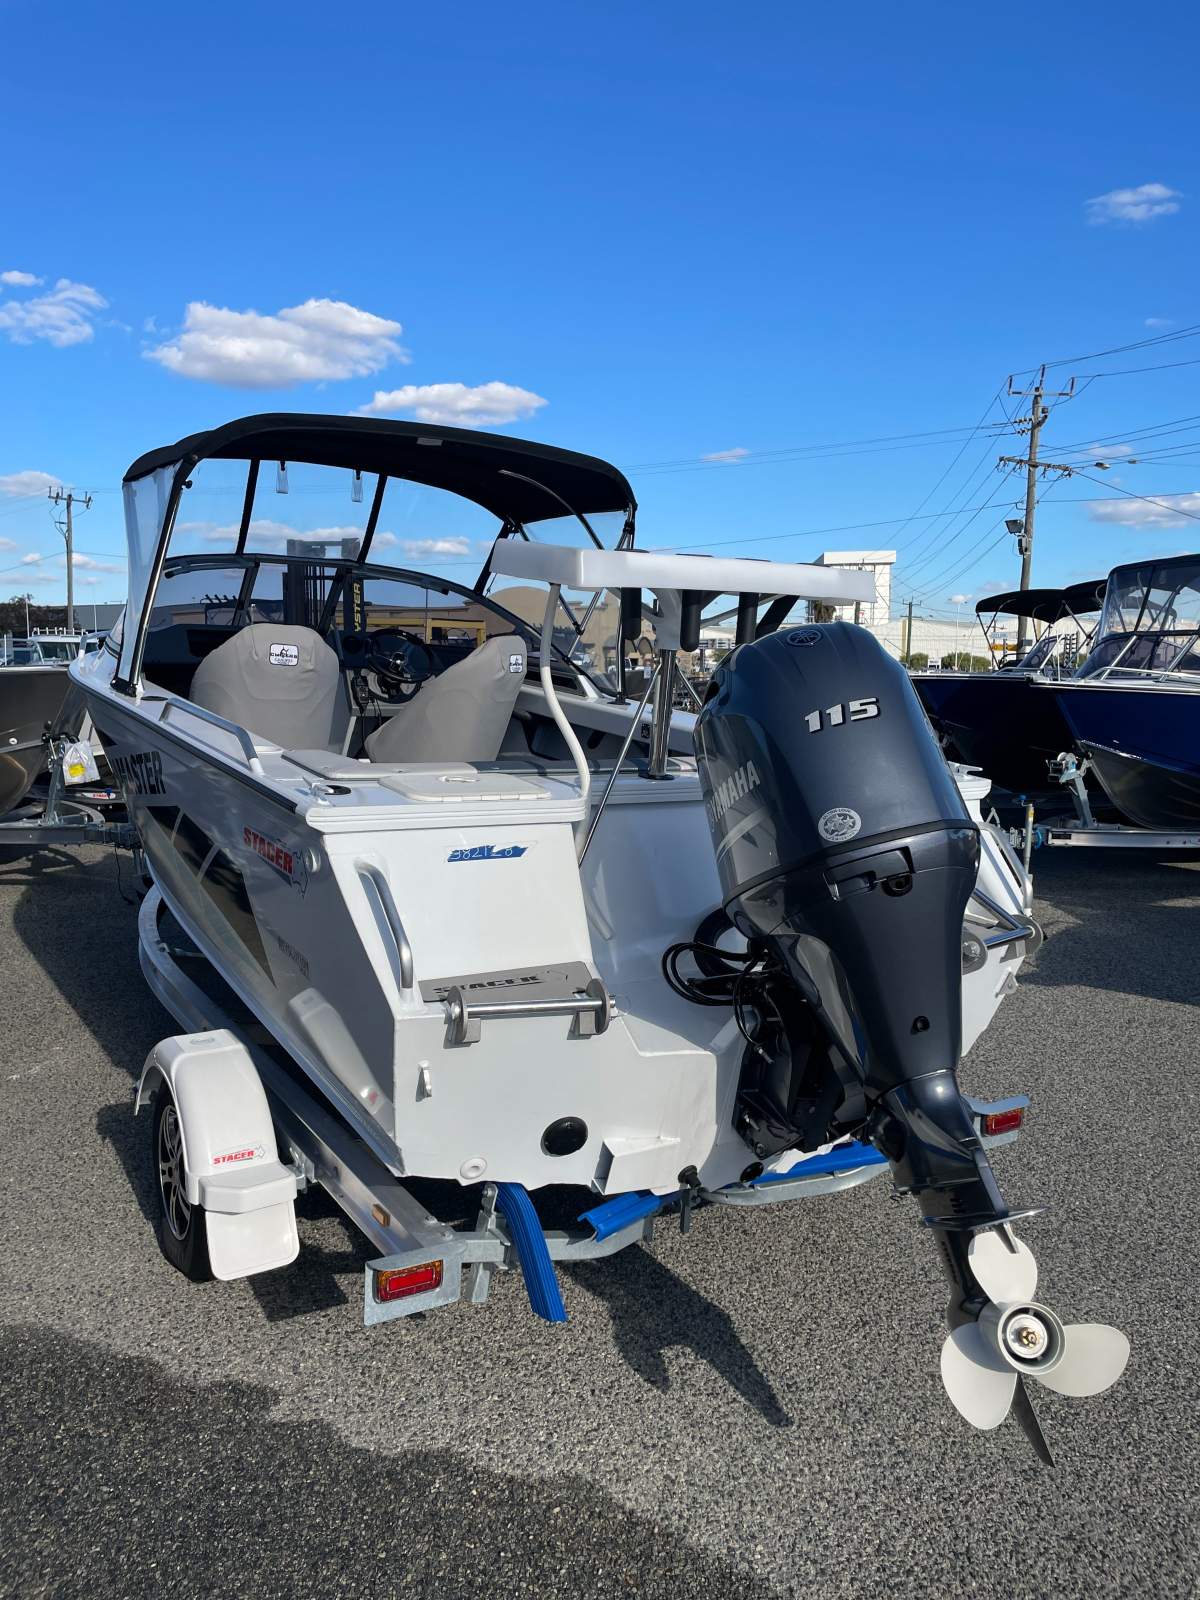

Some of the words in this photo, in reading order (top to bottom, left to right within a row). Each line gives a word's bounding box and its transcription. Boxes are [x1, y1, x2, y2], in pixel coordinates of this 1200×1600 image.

[804, 697, 879, 733] 115
[710, 760, 761, 822] YAMAHA
[243, 827, 294, 876] STACER
[213, 1150, 255, 1165] STACER
